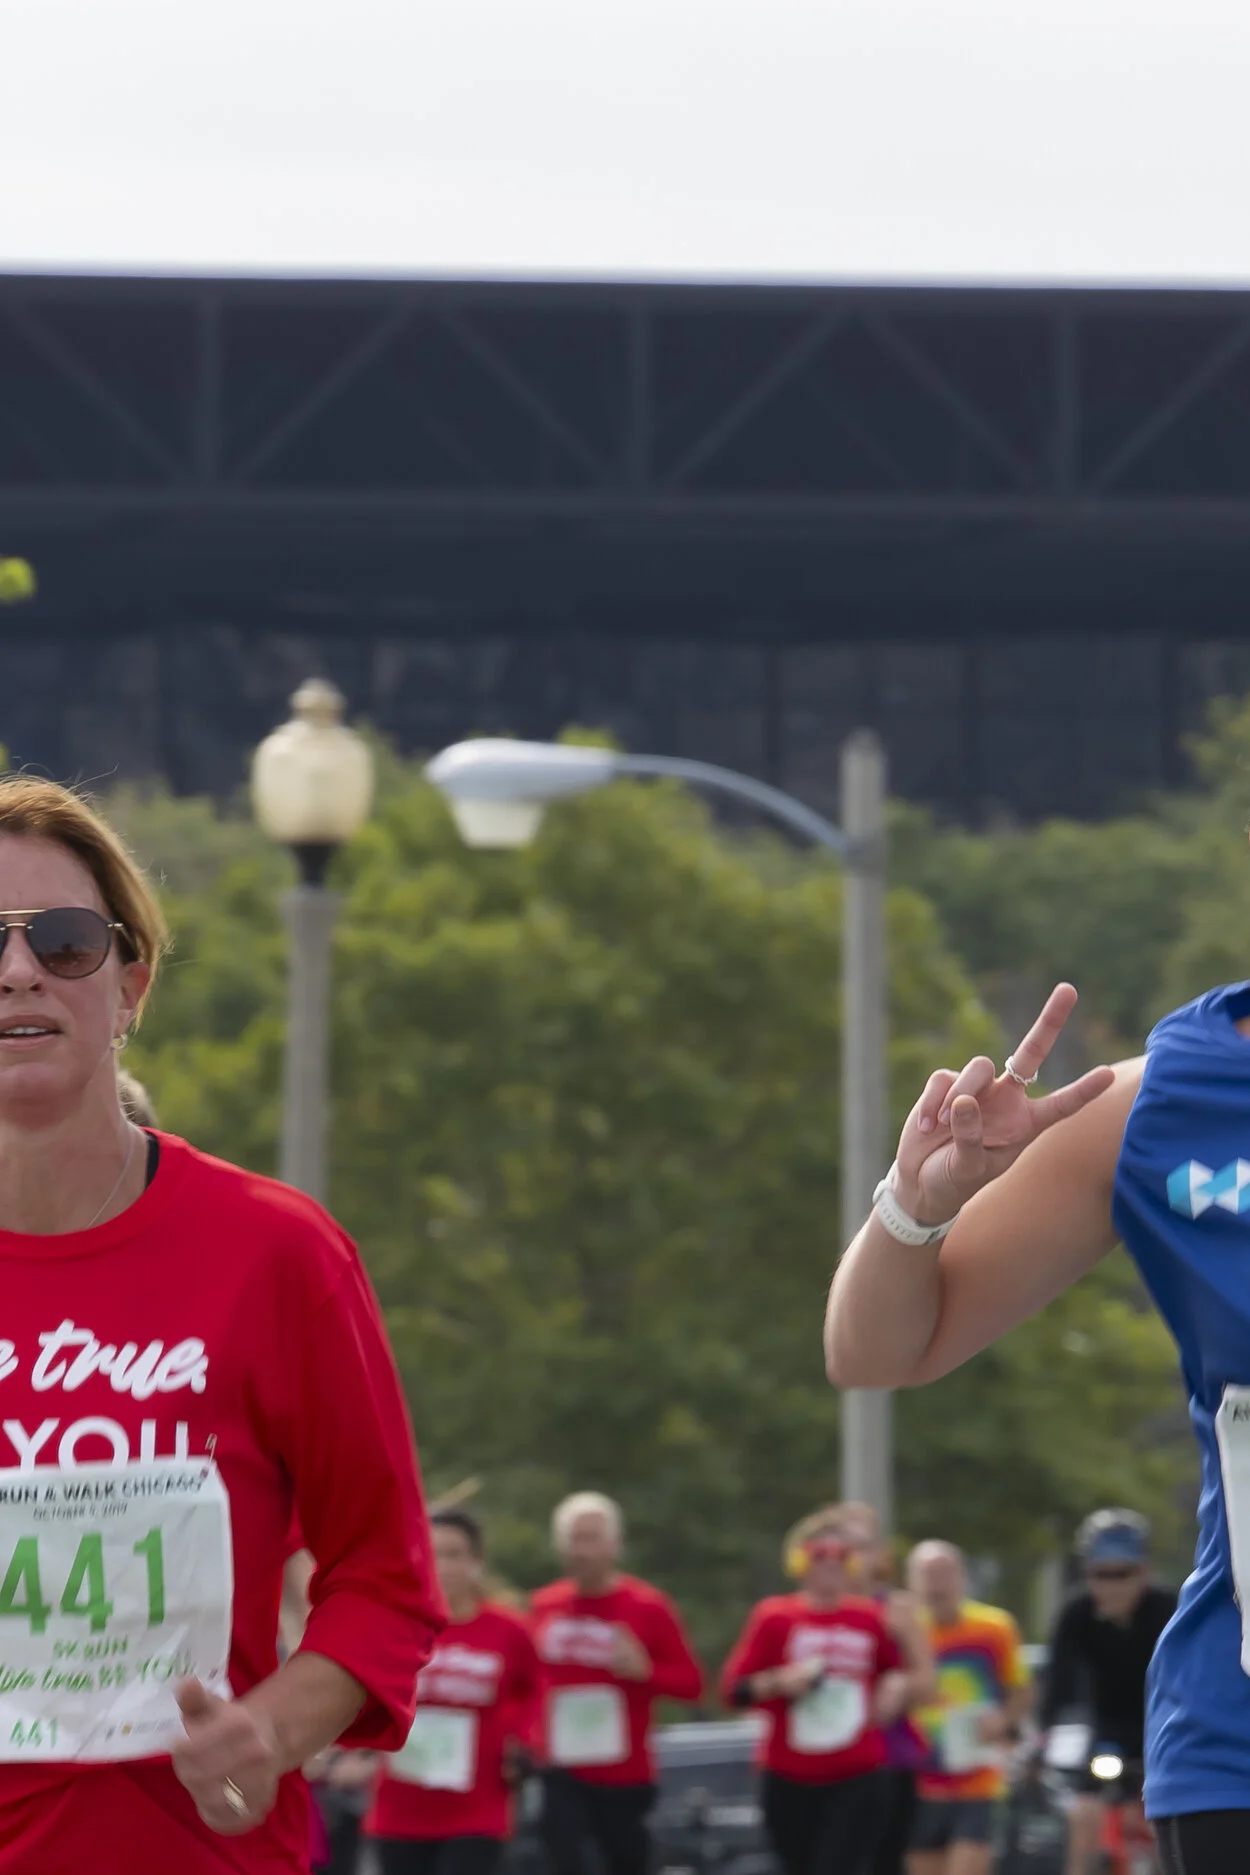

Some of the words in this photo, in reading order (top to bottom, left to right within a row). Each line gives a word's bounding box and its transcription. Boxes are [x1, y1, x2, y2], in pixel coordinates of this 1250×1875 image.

[64, 1480, 114, 1501] WALK
[122, 1472, 200, 1498] CHICAGO
[0, 1523, 164, 1635] 441
[83, 1634, 128, 1661] RUN
[10, 1717, 58, 1749] 441
